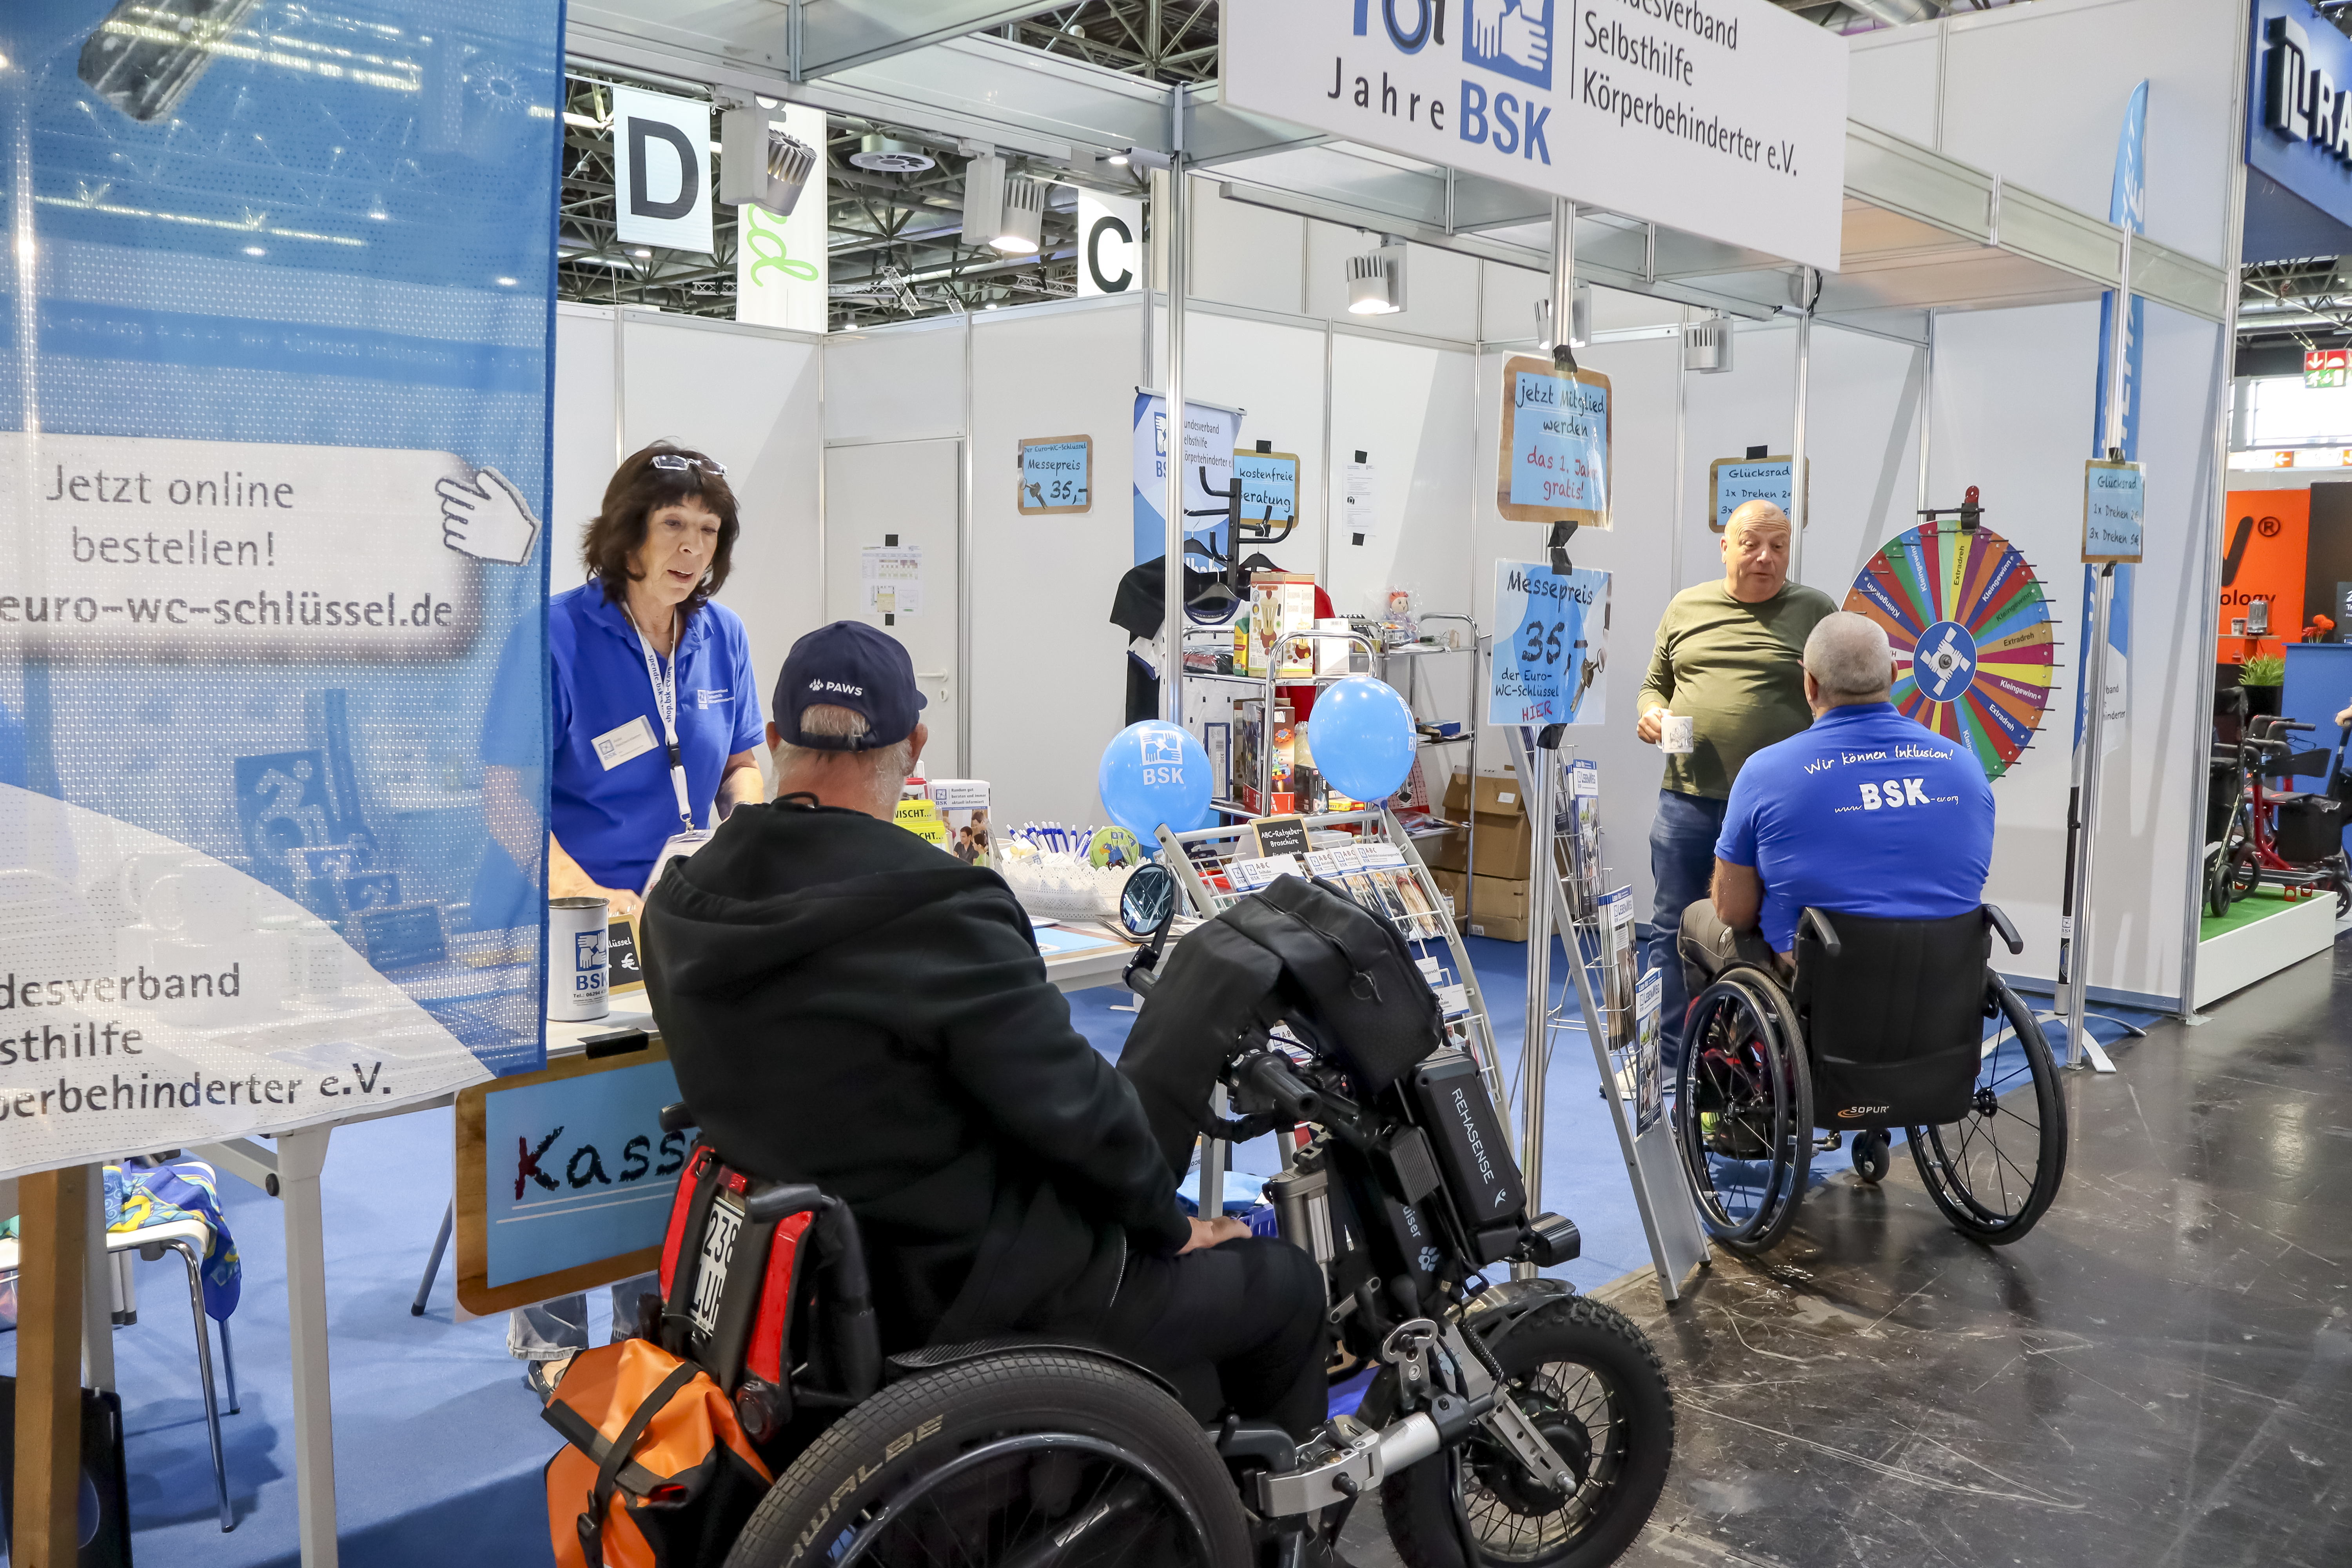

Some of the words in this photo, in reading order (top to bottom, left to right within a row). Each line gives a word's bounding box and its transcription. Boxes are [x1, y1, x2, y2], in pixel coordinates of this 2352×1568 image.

[1585, 10, 1693, 86] Selbsthilfe
[1328, 56, 1444, 131] Jahre
[1460, 79, 1552, 166] BSK
[1583, 67, 1761, 163] Körperbehinderter
[1768, 140, 1797, 176] e.V.
[628, 117, 699, 220] D
[1088, 216, 1133, 293] C
[1516, 378, 1553, 408] jetzt
[1560, 389, 1605, 417] Mitglied
[1184, 420, 1219, 434] undesverband
[1543, 415, 1588, 437] werden
[1035, 442, 1087, 452] Euro-WC-Schlüssel
[1184, 436, 1207, 448] elbsthilfe
[1027, 459, 1080, 476] Messepreis
[1184, 450, 1227, 467] örperbehinderter
[1527, 445, 1553, 469] das
[1559, 456, 1569, 474] 1.
[1240, 467, 1294, 483] kostenfreie
[1728, 466, 1791, 479] Glücksrad
[2098, 475, 2137, 490] Glücksrad
[46, 463, 152, 505] Jetzt
[168, 471, 294, 509] online
[1543, 481, 1584, 501] gratis!
[1726, 489, 1737, 497] 1x
[1742, 488, 1777, 499] Drehen
[2094, 503, 2102, 515] 1x
[2105, 504, 2128, 519] Drehen
[73, 526, 276, 567] bestellen!
[2089, 527, 2099, 540] 3x
[2103, 529, 2127, 544] Drehen
[1954, 546, 1965, 585] Extradreh
[1507, 570, 1593, 613] Messepreis
[1982, 560, 2012, 602] Kleingewinn
[0, 590, 453, 628] euro-wc-schlüssel.de
[1996, 592, 2032, 622] Kleingewinn
[2004, 633, 2034, 646] Extradreh
[1501, 667, 1520, 681] der
[1524, 669, 1552, 682] Euro-
[826, 681, 863, 696] PAWS
[1495, 684, 1560, 697] WC-Schlüssel
[2000, 679, 2037, 700] Kleingewinn
[2105, 684, 2119, 694] band
[1522, 701, 1553, 723] HIER
[1989, 704, 2015, 731] Extradreh
[1804, 758, 1835, 775] Wir
[1842, 749, 1887, 766] können
[1895, 744, 1954, 760] Inklusion!
[1143, 767, 1185, 786] BSK
[1261, 827, 1303, 839] ABC-Ratgeber-
[1270, 838, 1299, 848] Broschüre
[576, 972, 608, 991] BSK
[319, 1062, 392, 1097] e.V.
[1451, 1087, 1495, 1185] REHASENSE
[514, 1126, 686, 1201] Kass
[1401, 1204, 1421, 1238] uiser
